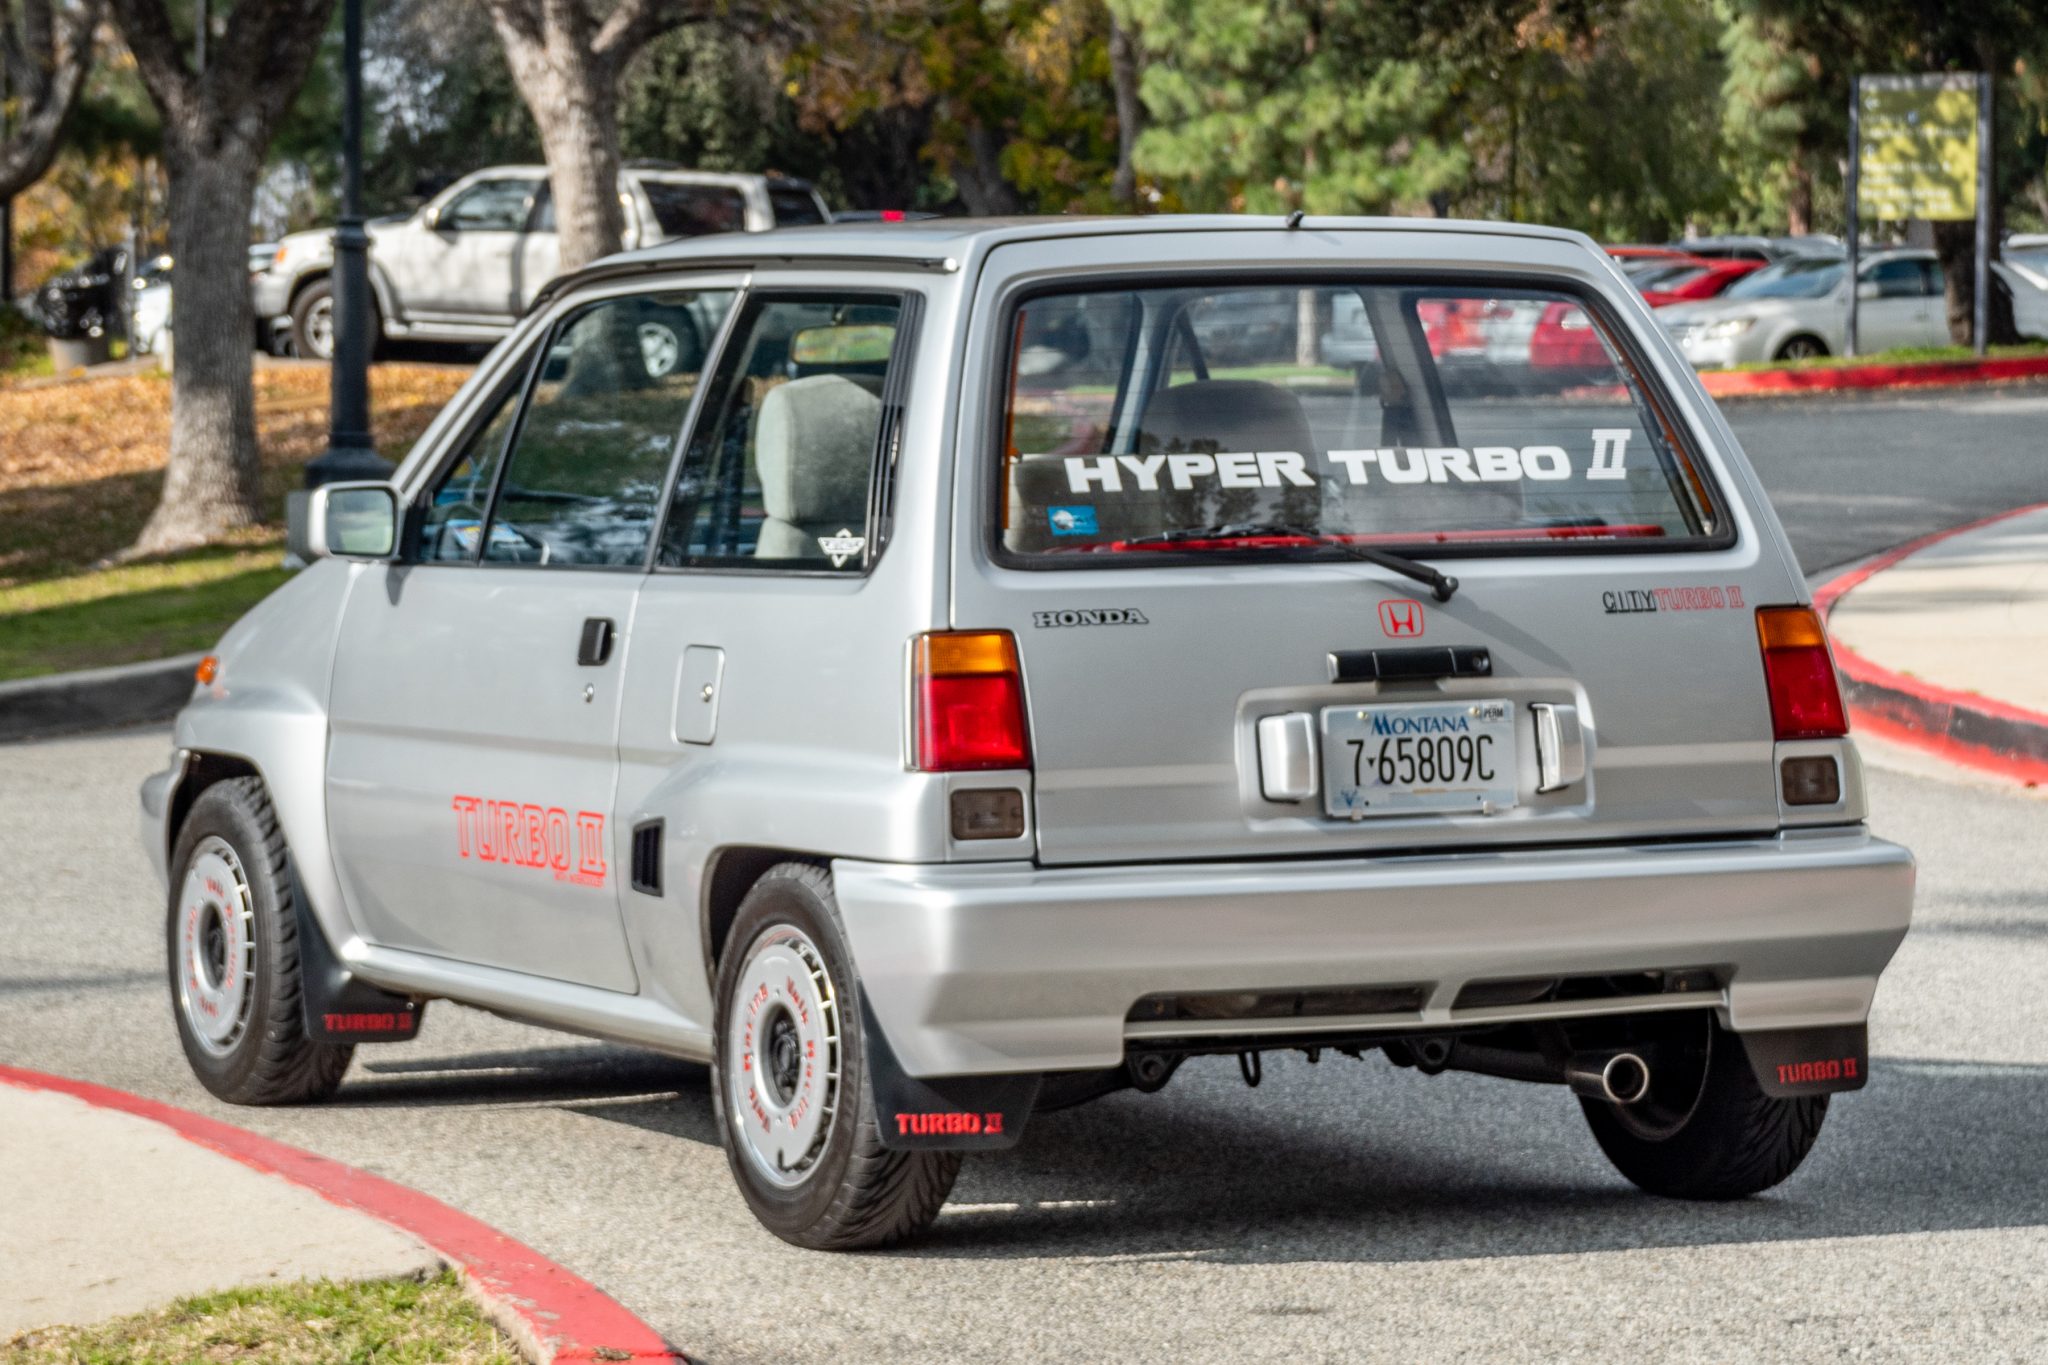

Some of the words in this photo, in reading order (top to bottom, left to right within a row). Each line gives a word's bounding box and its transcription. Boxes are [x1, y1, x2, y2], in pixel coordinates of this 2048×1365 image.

[1064, 451, 1315, 493] HYPER
[1328, 446, 1572, 485] TURBO
[1032, 608, 1149, 628] HONDA
[453, 795, 571, 871] TURBO
[1776, 1060, 1840, 1084] TURBO
[895, 1112, 980, 1134] TURBO
